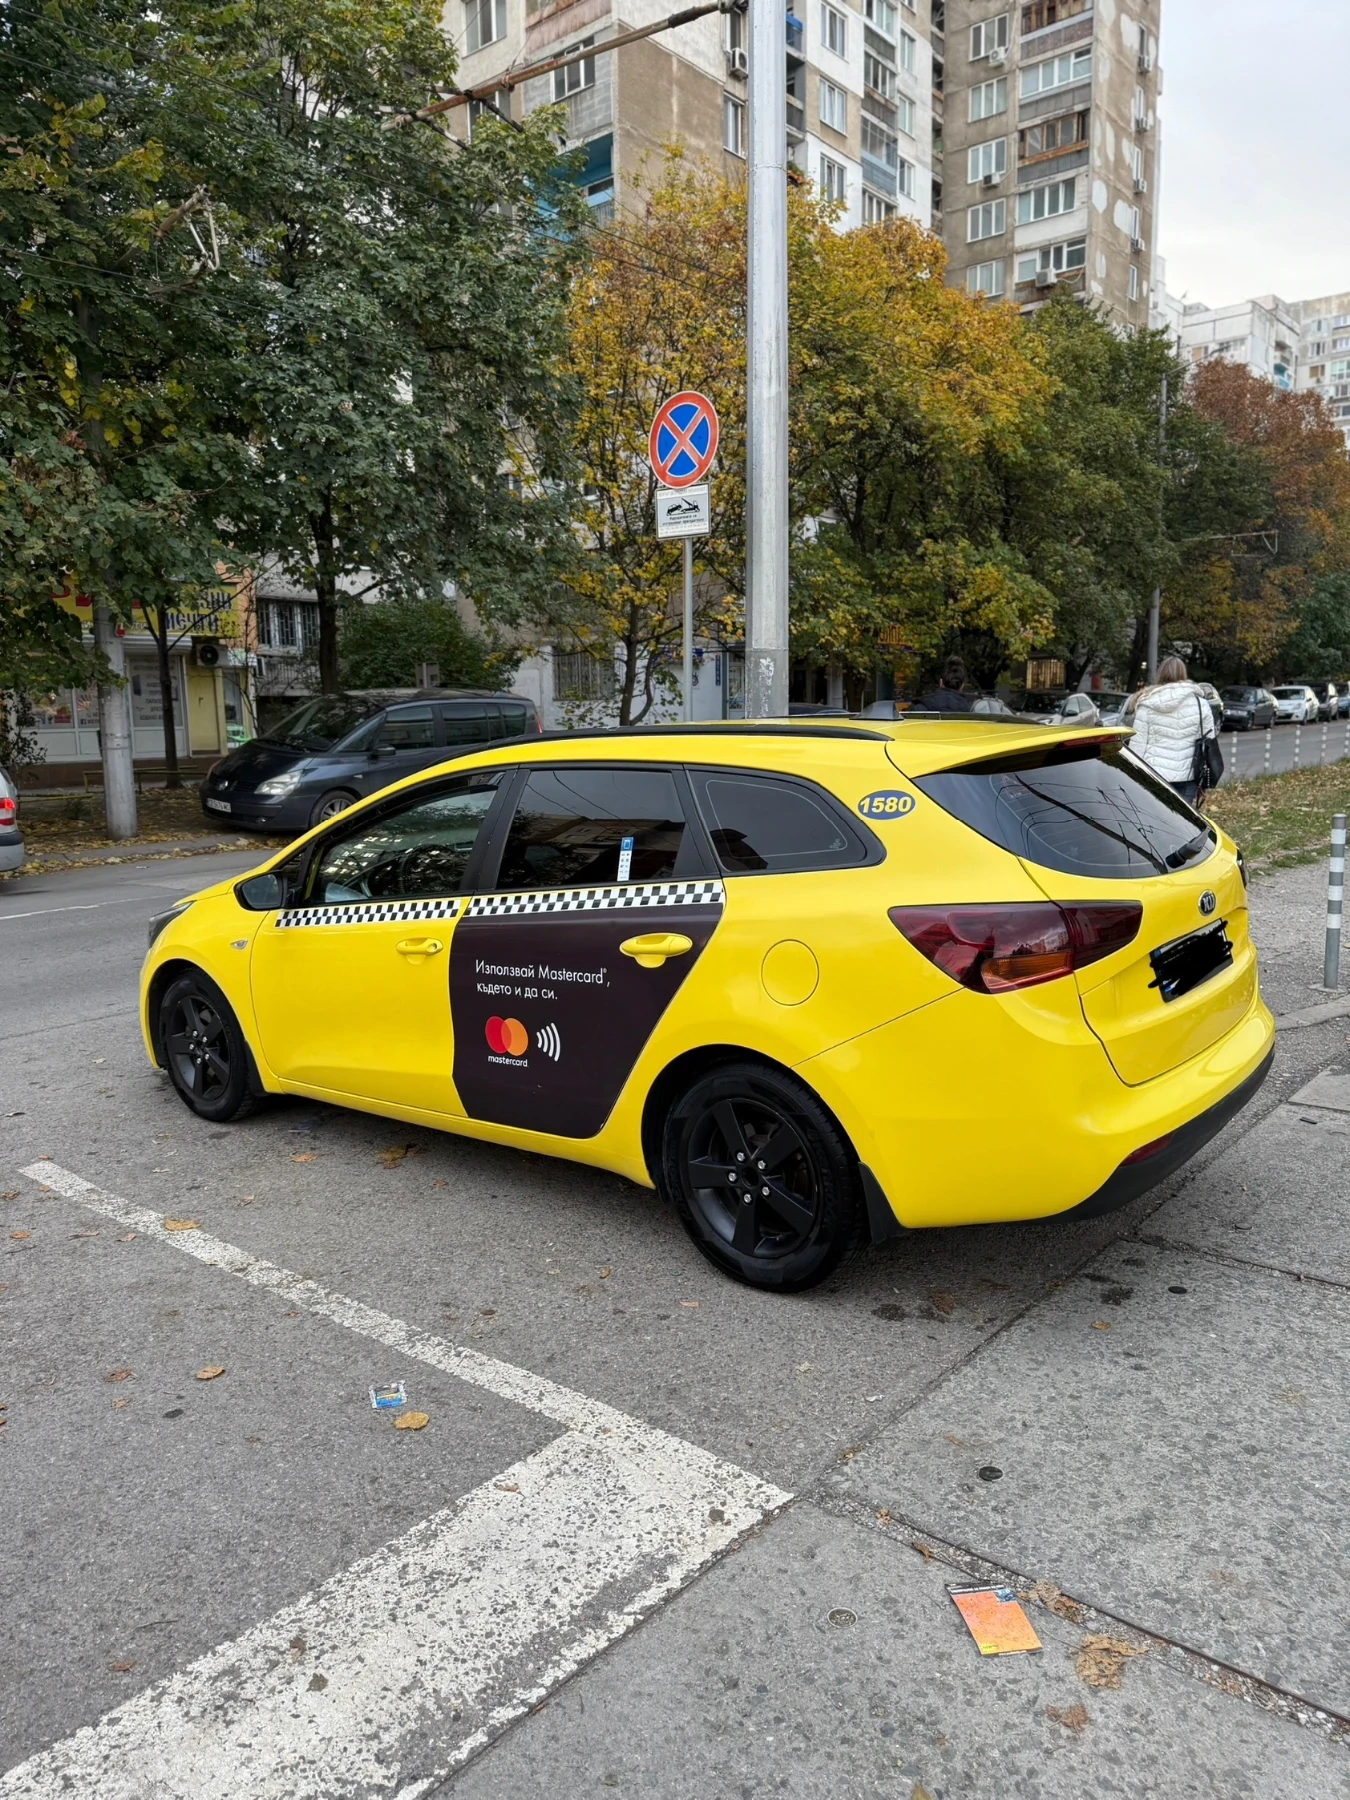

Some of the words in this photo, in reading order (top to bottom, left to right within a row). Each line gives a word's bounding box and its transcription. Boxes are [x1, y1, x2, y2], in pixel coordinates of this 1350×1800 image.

[859, 796, 912, 813] 1580
[475, 959, 535, 978] Използвай
[476, 982, 512, 996] където
[514, 986, 522, 996] и
[524, 987, 539, 999] да
[541, 988, 558, 1000] си.
[487, 1055, 528, 1067] mastercard
